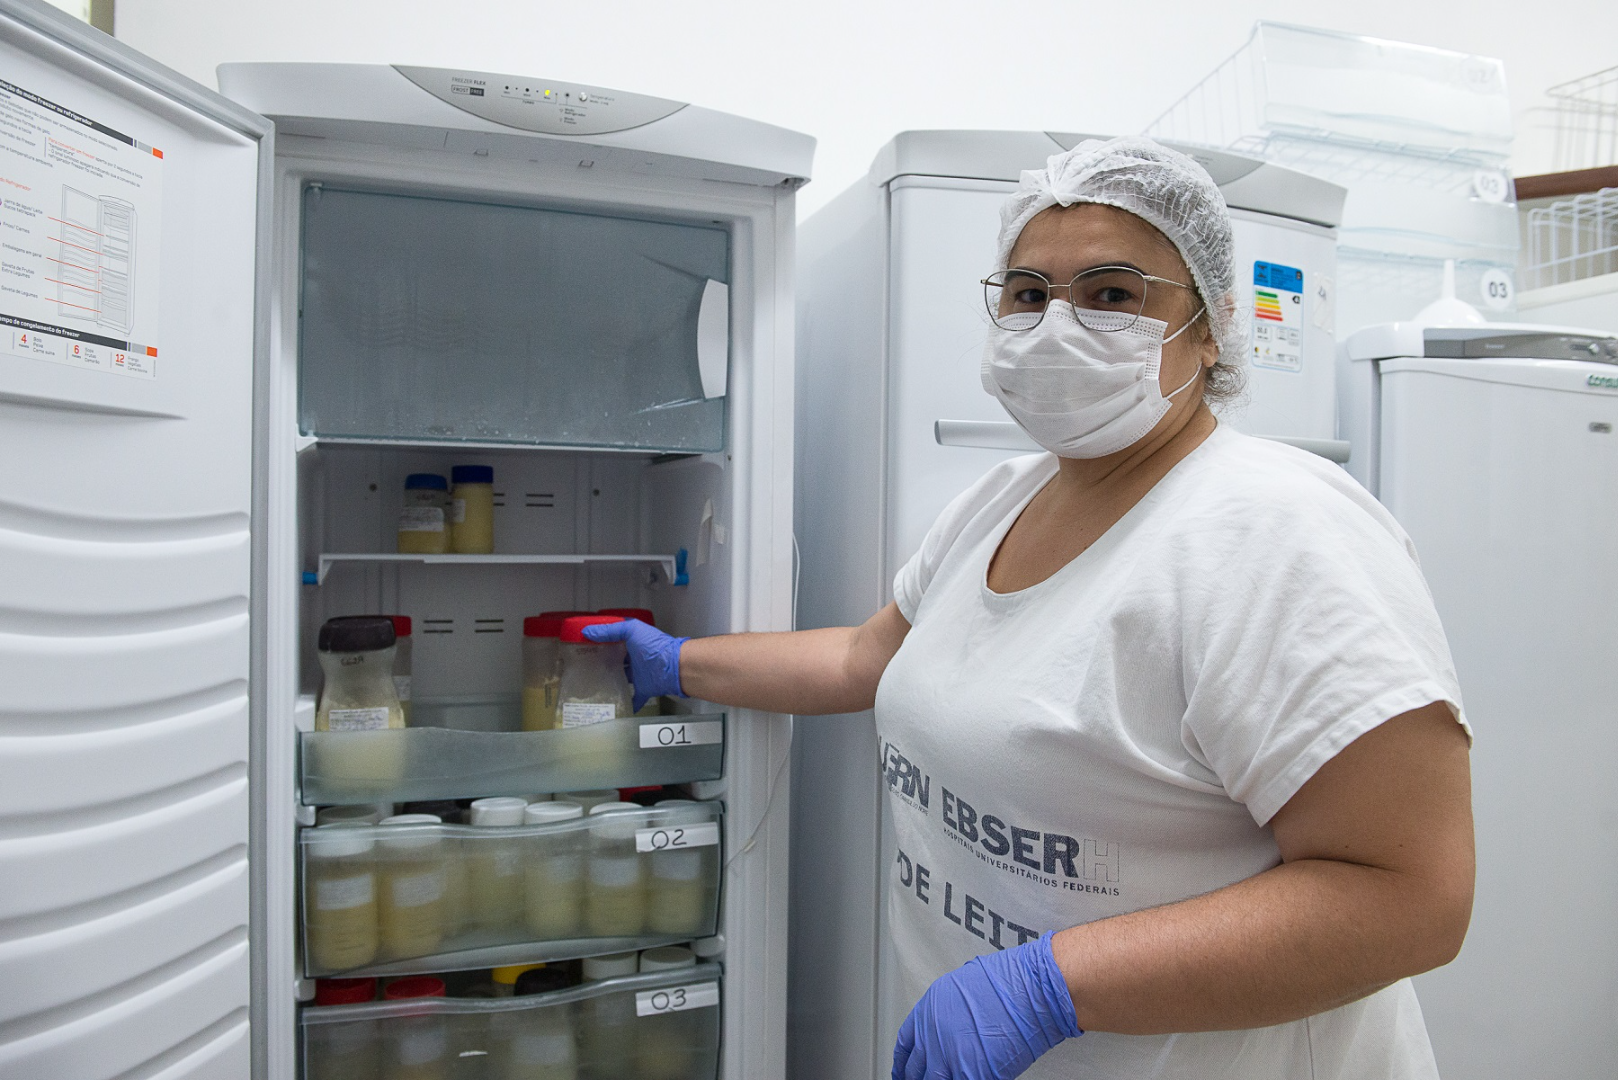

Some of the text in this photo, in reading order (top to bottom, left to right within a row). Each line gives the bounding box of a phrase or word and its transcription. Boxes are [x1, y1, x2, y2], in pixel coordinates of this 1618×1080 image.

[22, 91, 36, 102] modo
[37, 96, 56, 110] freezer
[63, 109, 92, 126] refrigerador
[1481, 176, 1499, 194] 03
[1489, 281, 1507, 299] 03
[20, 321, 54, 332] congelamento
[61, 328, 79, 337] freezer
[21, 334, 27, 343] 4
[74, 345, 79, 354] 6
[115, 353, 124, 363] 12
[1588, 374, 1618, 389] consu
[658, 725, 692, 745] 01
[651, 828, 687, 849] 02
[942, 786, 1120, 882] EBSERH
[944, 826, 1120, 896] HOSPITAIS UNIVERSITÁRIOS FEDERAIS
[897, 848, 1039, 950] DE LEIT
[651, 988, 686, 1010] 03
